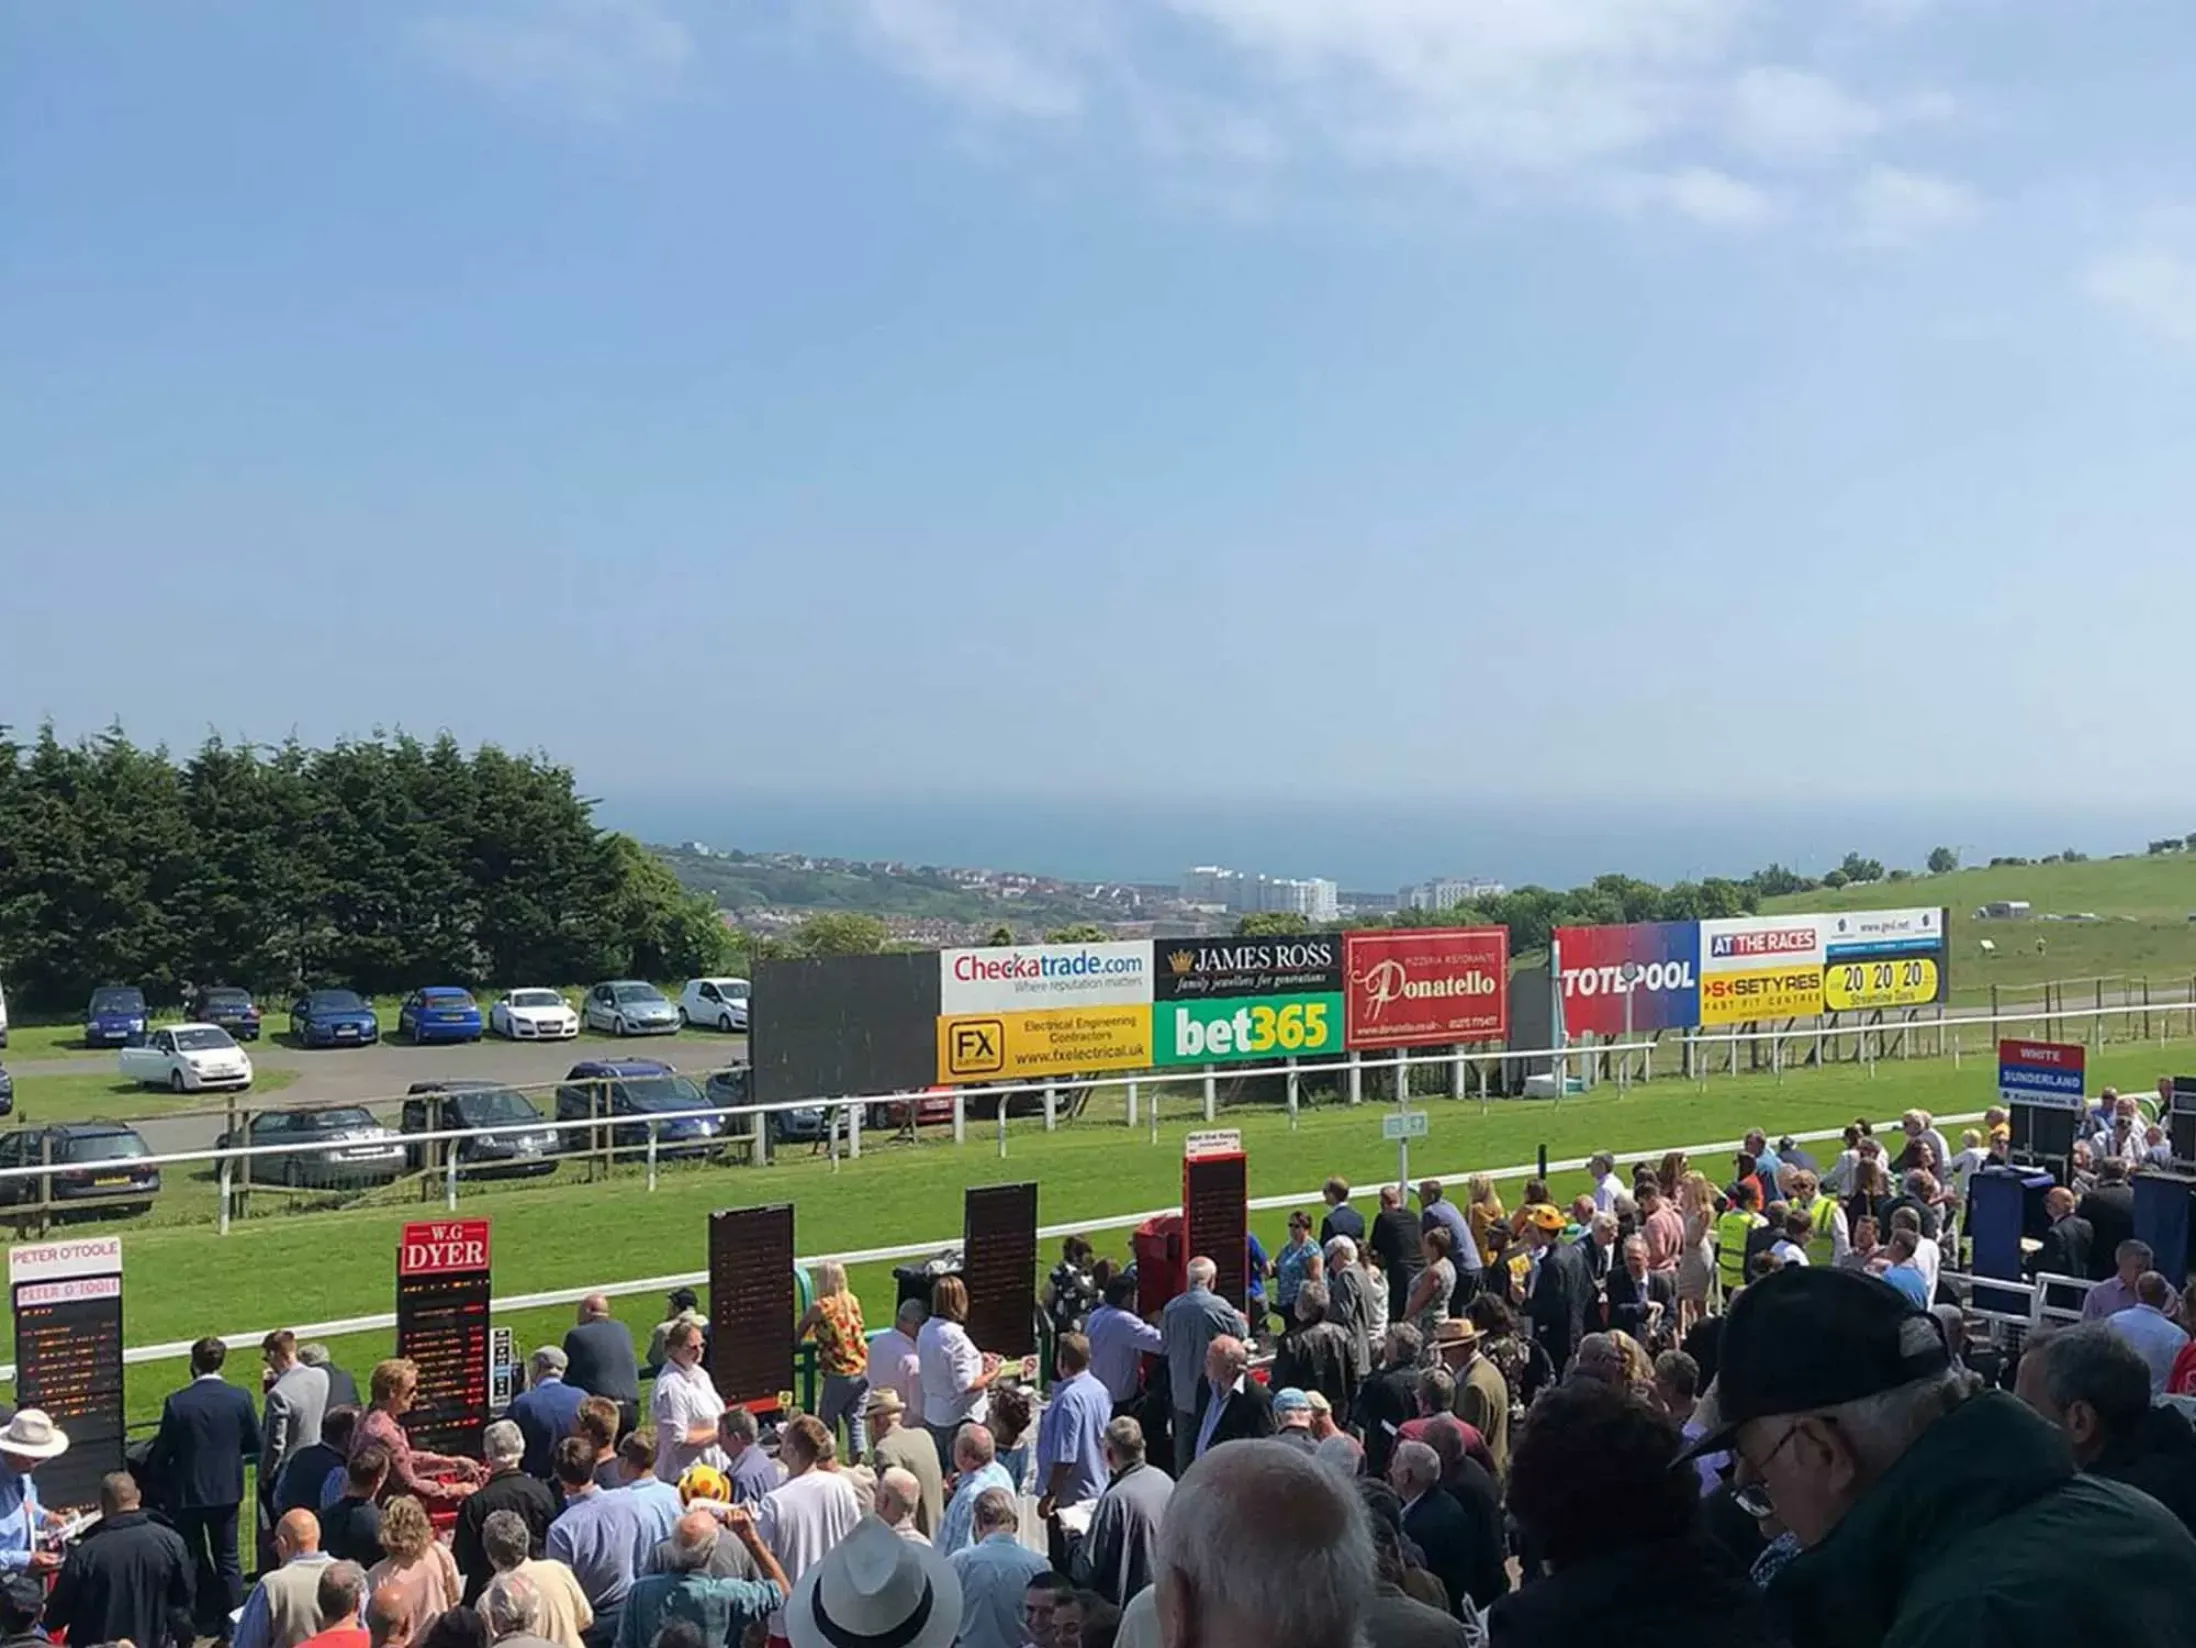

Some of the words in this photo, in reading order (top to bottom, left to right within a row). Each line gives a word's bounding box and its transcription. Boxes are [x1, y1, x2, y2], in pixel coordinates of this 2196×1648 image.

[1713, 937, 1733, 955] AT
[1738, 935, 1766, 952] THE
[1768, 931, 1814, 950] RACES
[954, 950, 1142, 981] Checkatrade.com
[1195, 945, 1270, 971] JAMES
[1276, 942, 1332, 968] ROSS
[1015, 980, 1047, 994] Where
[1049, 976, 1100, 994] reputation
[1105, 975, 1143, 988] matters
[1255, 973, 1272, 988] for
[1735, 972, 1820, 996] SETYRES
[1844, 966, 1863, 992] 20
[1873, 964, 1893, 989] 20
[1903, 961, 1922, 986] 20
[1351, 959, 1496, 1021] Donatello
[1704, 1000, 1734, 1011] FAST
[1742, 997, 1760, 1008] FIT
[1768, 993, 1820, 1006] CENTRES
[1024, 1018, 1073, 1032] Electrical
[1076, 1015, 1136, 1029] Engineering
[1175, 1003, 1328, 1056] bet365
[957, 1029, 994, 1058] FX
[1049, 1030, 1112, 1044] Contractors
[1015, 1044, 1144, 1065] www.fxelectrical.uk
[2021, 1048, 2060, 1062] WHITE
[2003, 1070, 2080, 1088] SUNDERLAND
[431, 1224, 463, 1240] W.G
[12, 1248, 57, 1263] PETER
[60, 1241, 117, 1260] O'TOOLE
[406, 1240, 484, 1268] DYER
[21, 1285, 58, 1300] PETER
